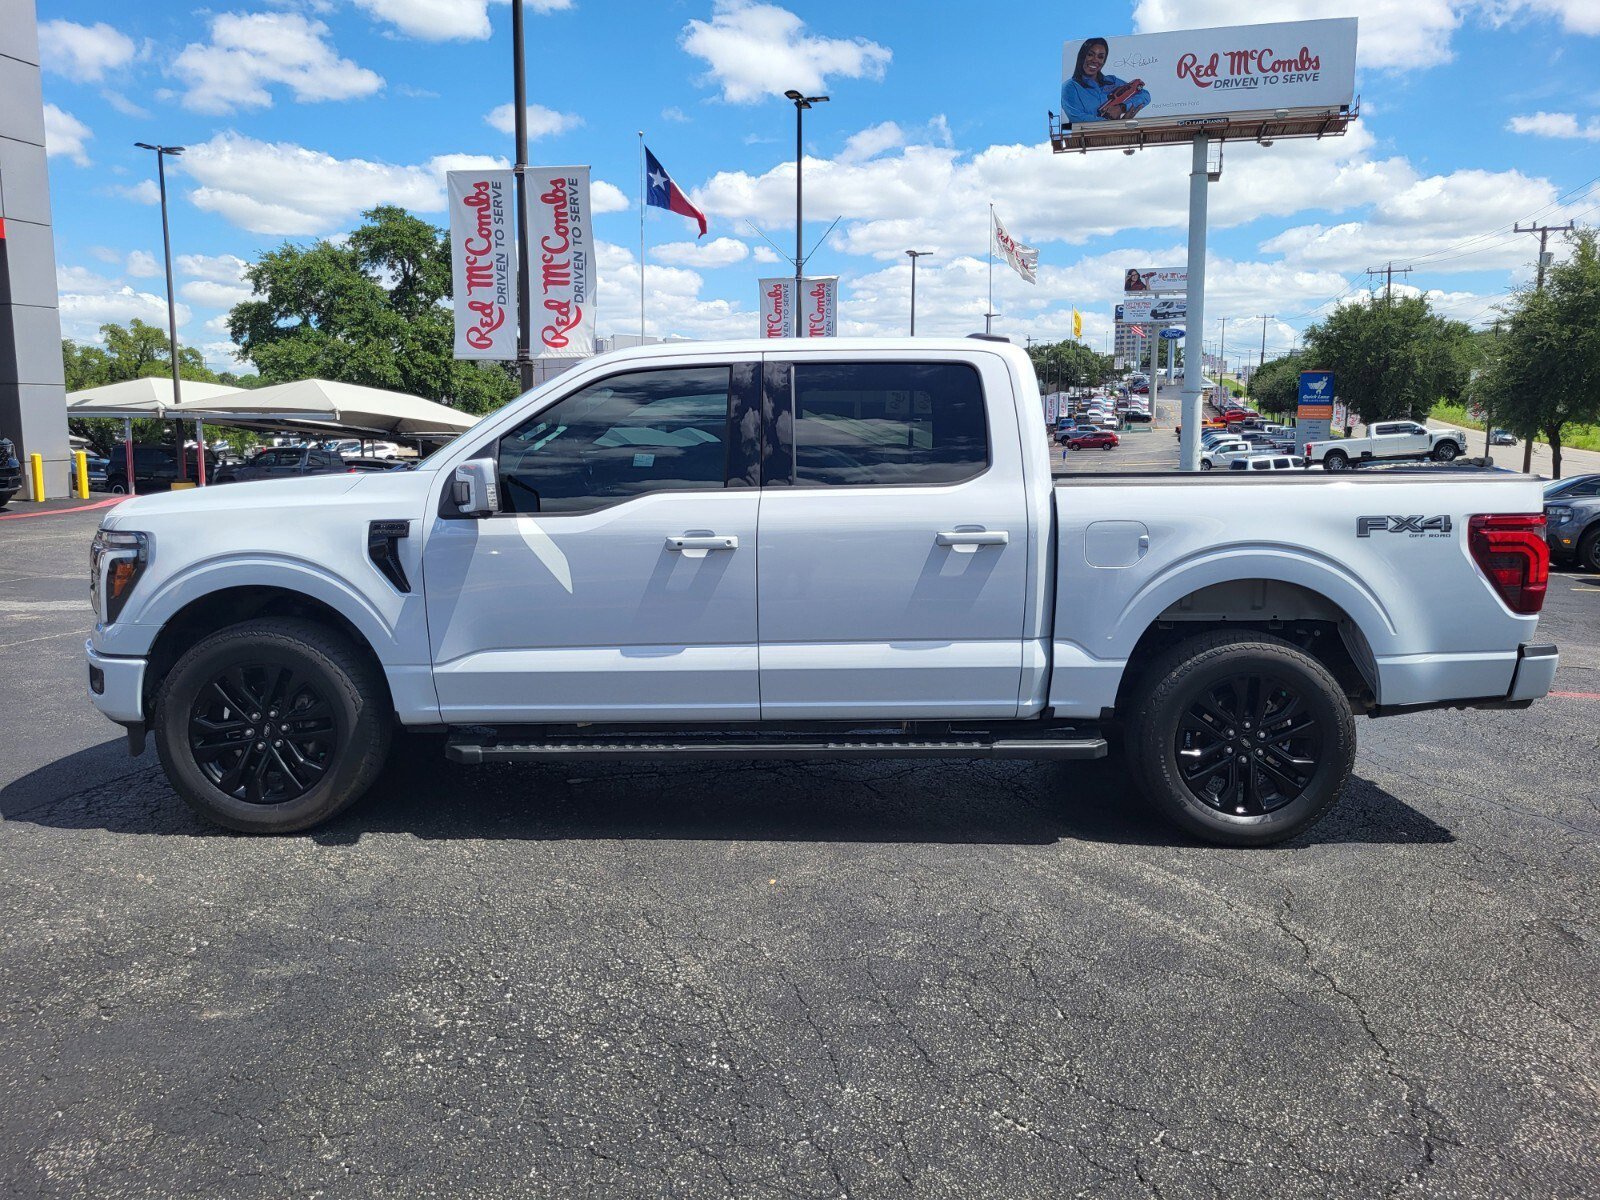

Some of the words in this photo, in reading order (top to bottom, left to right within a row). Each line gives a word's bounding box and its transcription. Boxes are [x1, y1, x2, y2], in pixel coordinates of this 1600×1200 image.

[1177, 53, 1219, 88] Red
[1223, 46, 1320, 76] McCombs
[1213, 77, 1259, 89] DRIVEN
[1263, 75, 1278, 85] TO
[1282, 73, 1320, 84] SERVE
[492, 181, 504, 225] SERVE
[568, 178, 581, 223] SERVE
[464, 181, 493, 296] McCombs
[495, 229, 505, 248] TO
[540, 178, 571, 295] McCombs
[572, 227, 582, 247] TO
[496, 252, 507, 305] DRIVEN
[573, 251, 584, 303] DRIVEN
[466, 301, 505, 349] Red
[541, 299, 582, 348] Red
[783, 309, 789, 319] TO
[826, 309, 832, 319] TO
[1164, 329, 1181, 337] Ford
[1356, 515, 1452, 538] FX4
